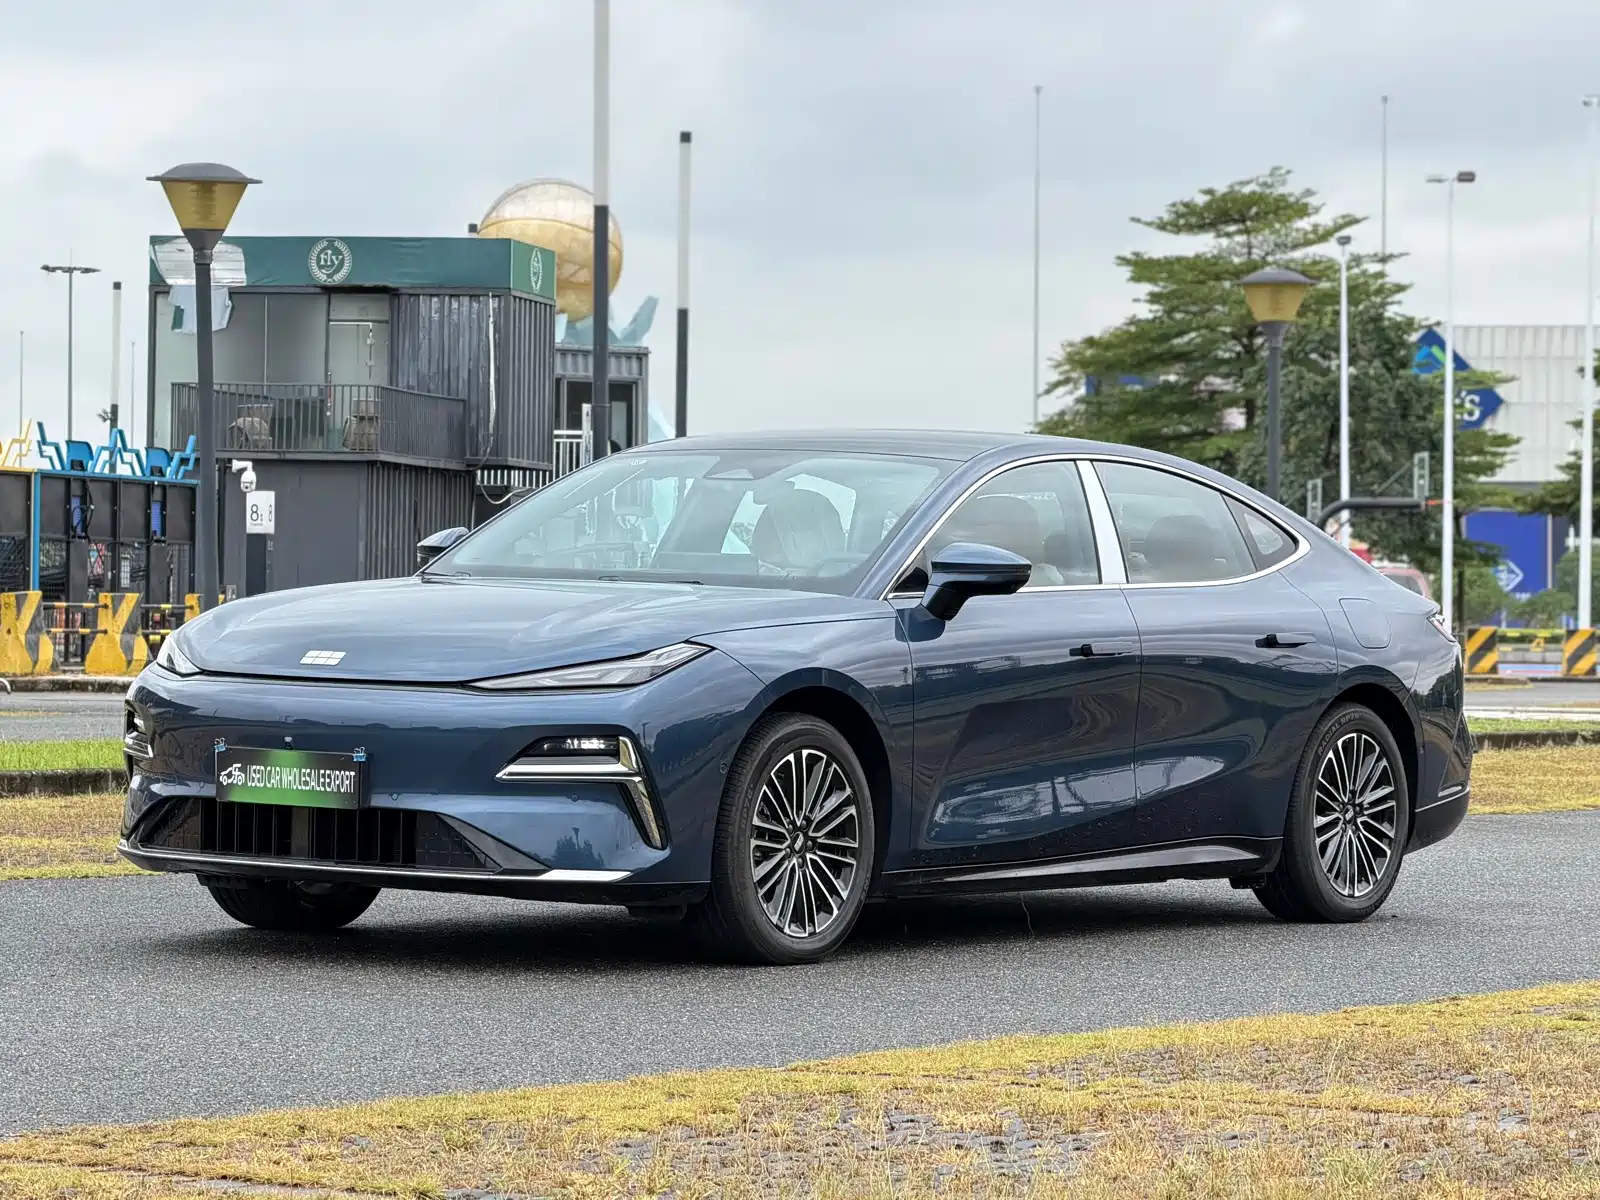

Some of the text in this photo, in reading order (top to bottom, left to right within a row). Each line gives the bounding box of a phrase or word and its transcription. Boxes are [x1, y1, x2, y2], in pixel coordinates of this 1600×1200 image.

[319, 249, 343, 273] fly
[250, 504, 259, 521] 8
[247, 764, 356, 793] USED CAR WHOLESALE EXPORT
